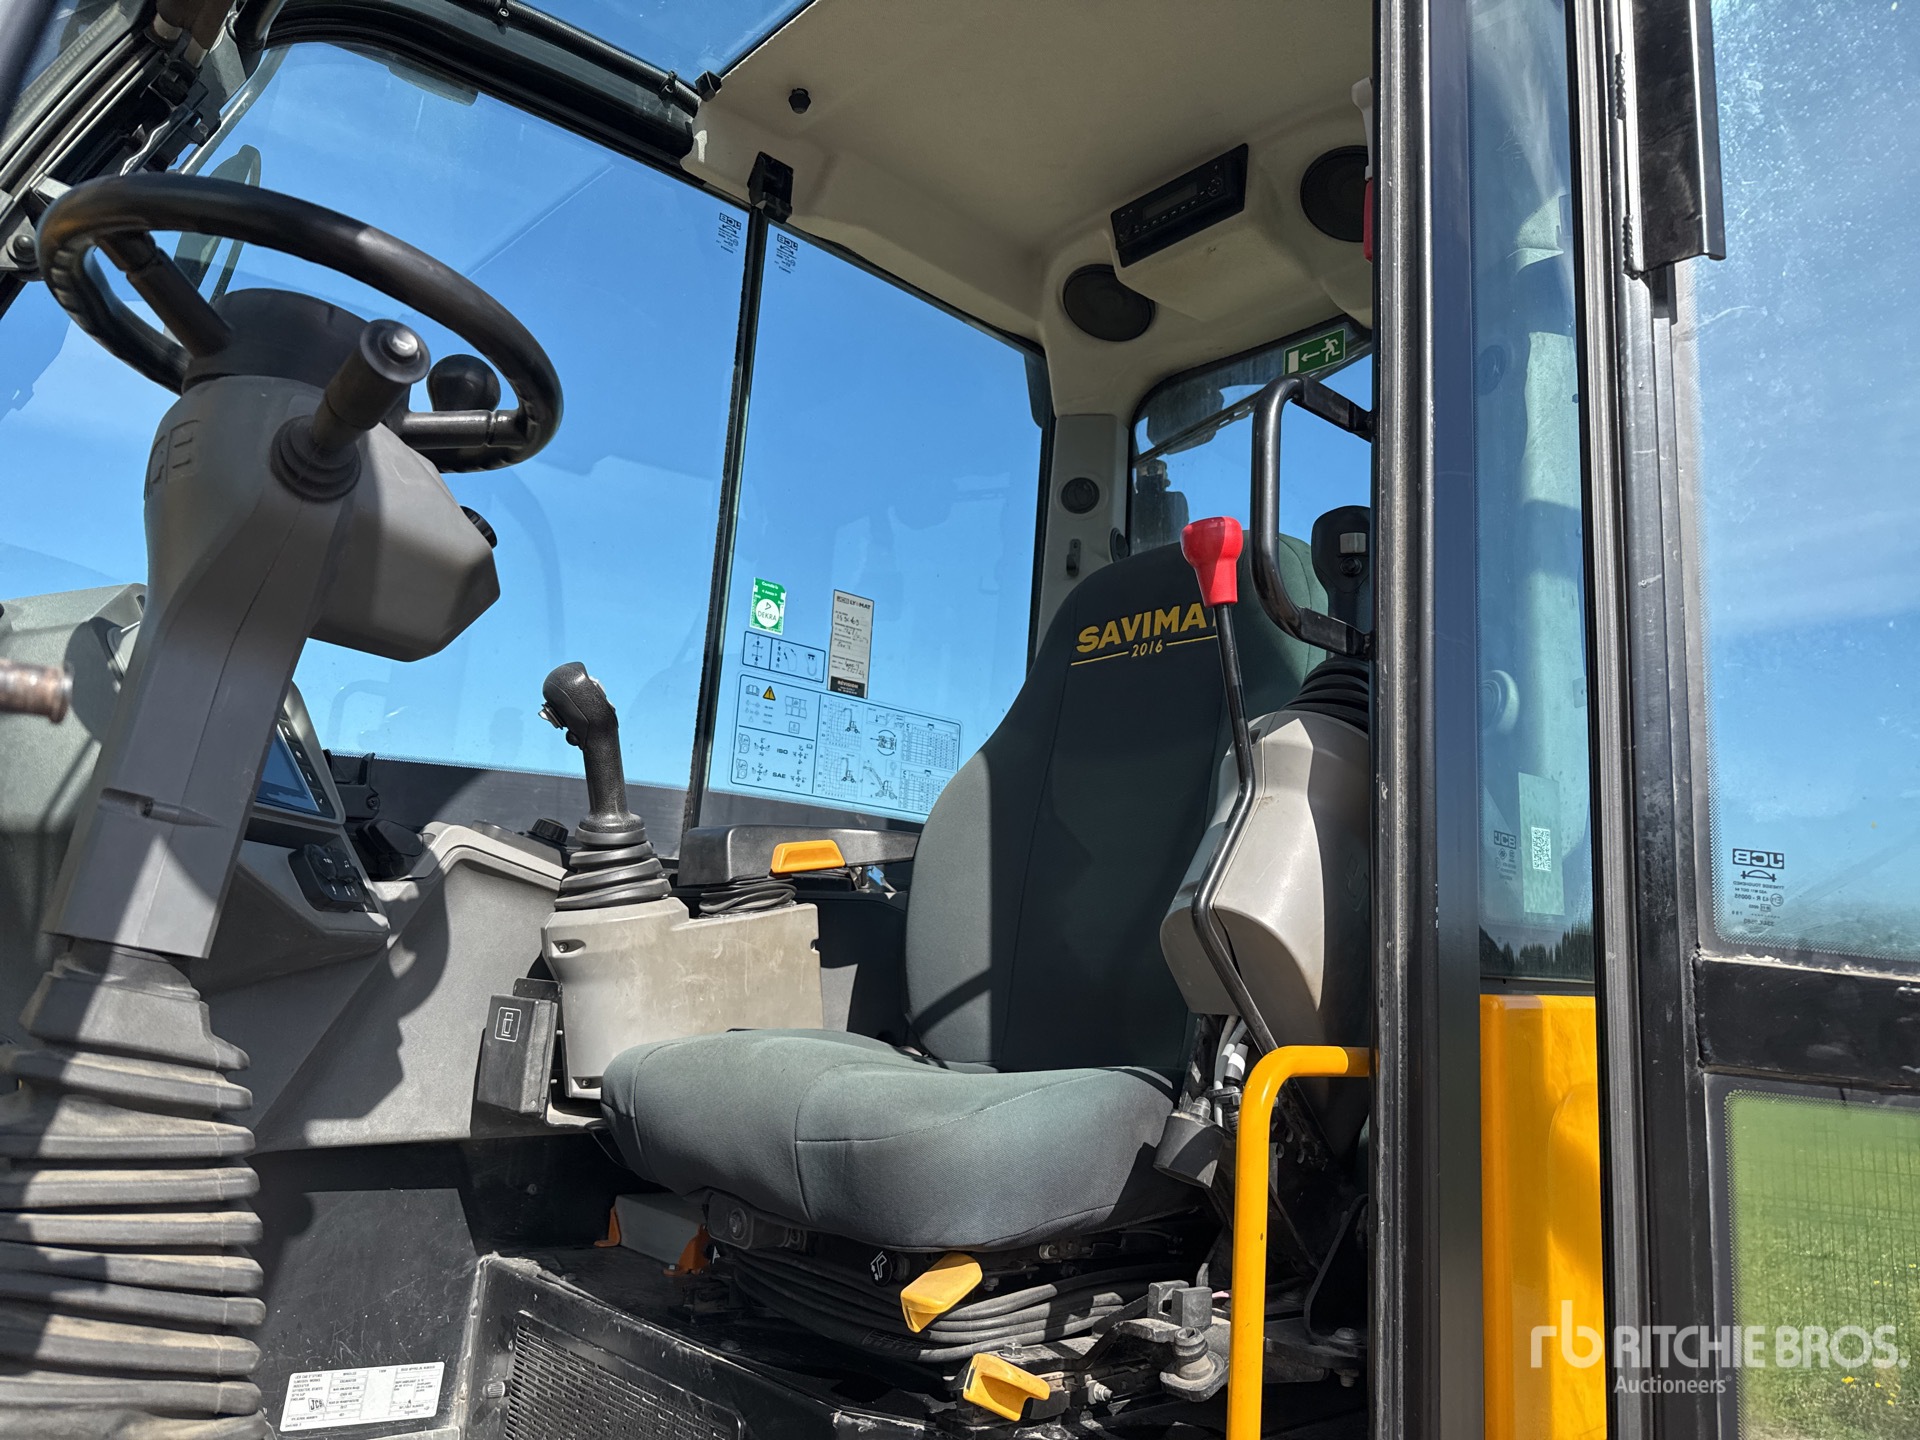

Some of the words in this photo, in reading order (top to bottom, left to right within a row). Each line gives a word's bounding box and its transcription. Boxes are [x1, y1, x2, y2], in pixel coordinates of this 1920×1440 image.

[757, 610, 777, 621] DEKRA
[1075, 602, 1217, 653] SAVIMA
[1131, 639, 1164, 659] 2016
[772, 771, 787, 779] SAE
[1494, 831, 1516, 849] JCB
